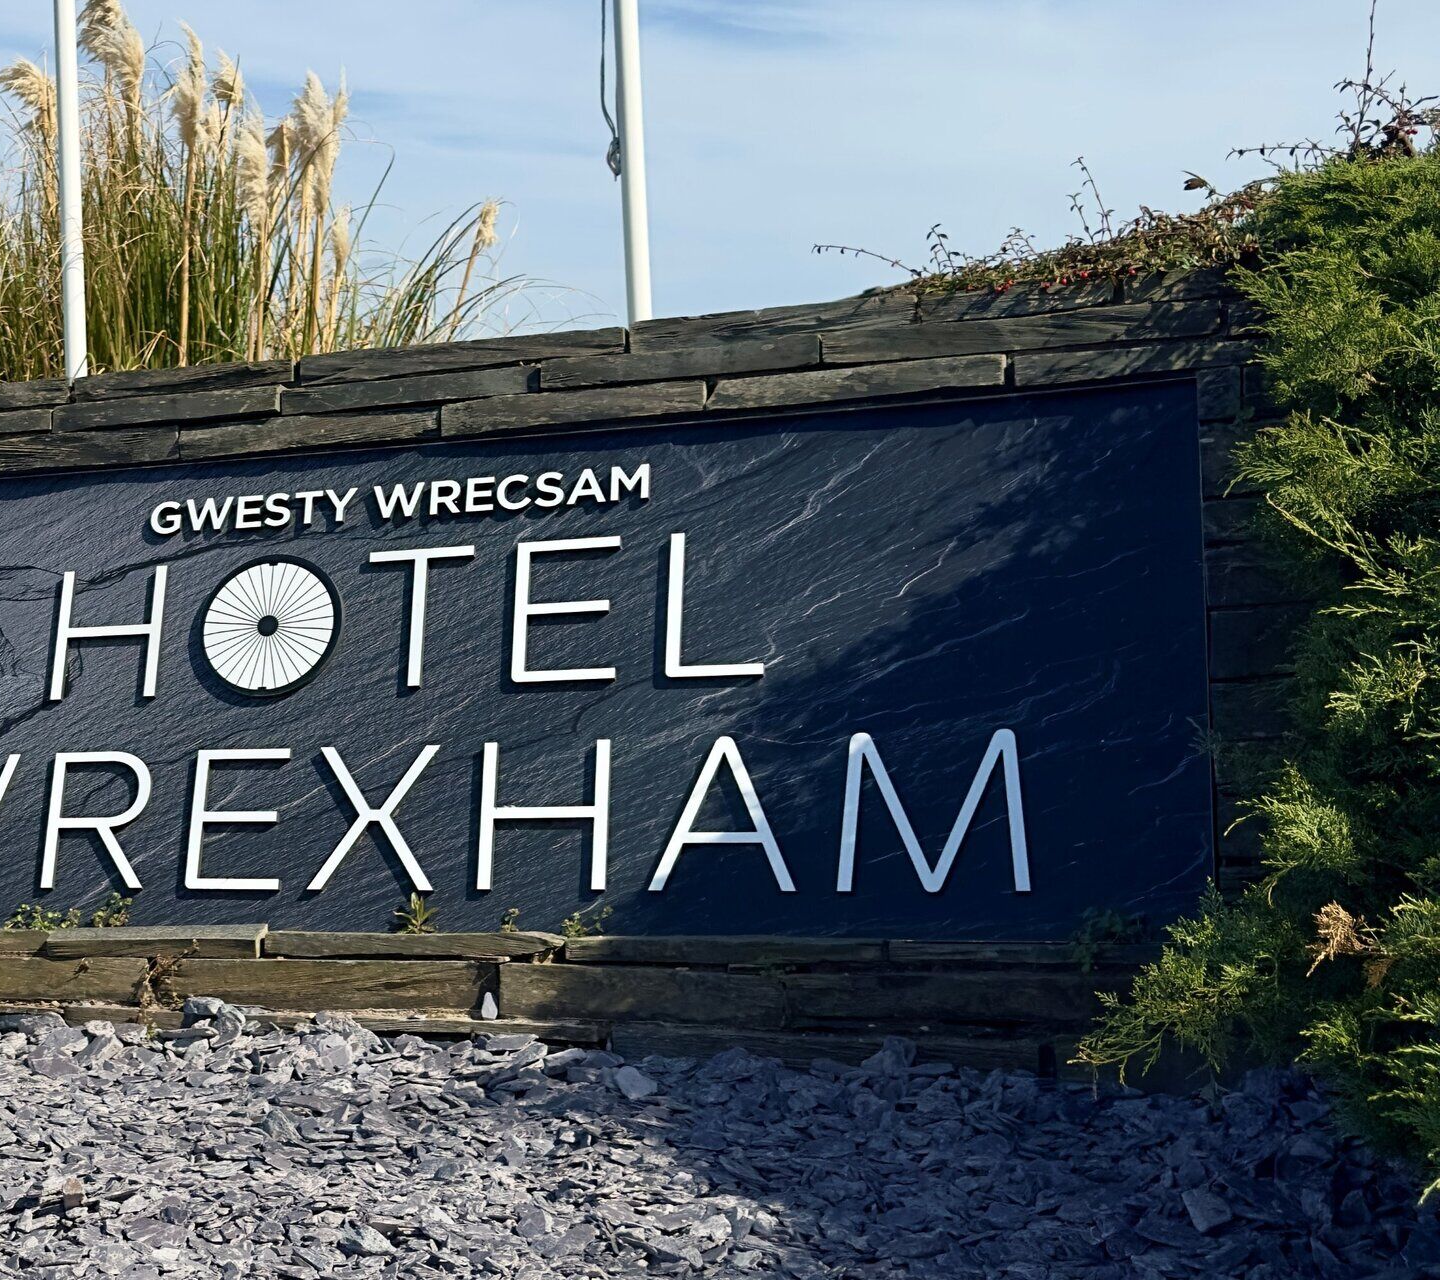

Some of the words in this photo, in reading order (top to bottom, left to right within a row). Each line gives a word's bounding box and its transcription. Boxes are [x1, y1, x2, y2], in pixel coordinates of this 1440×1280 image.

[150, 487, 357, 537] GWESTY
[373, 463, 651, 521] WRECSAM
[48, 531, 767, 702] HOTEL
